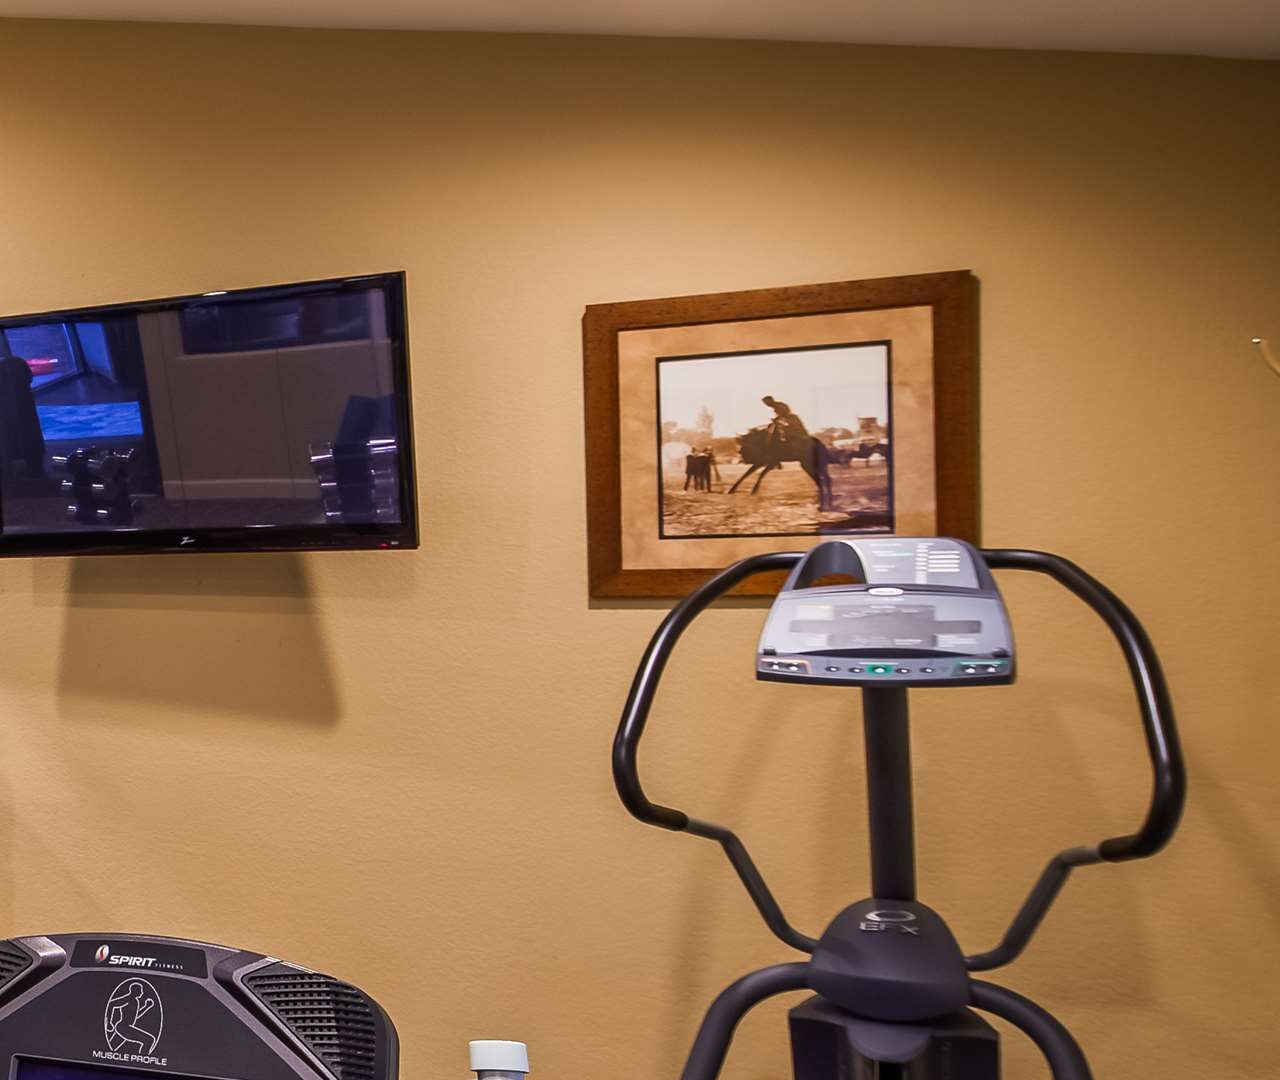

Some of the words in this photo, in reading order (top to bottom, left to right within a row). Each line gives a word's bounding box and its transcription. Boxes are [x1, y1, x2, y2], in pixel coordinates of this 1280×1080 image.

[108, 955, 157, 967] SPIRIT
[92, 1050, 130, 1062] MUSCLE
[130, 1054, 168, 1066] PROFILE
